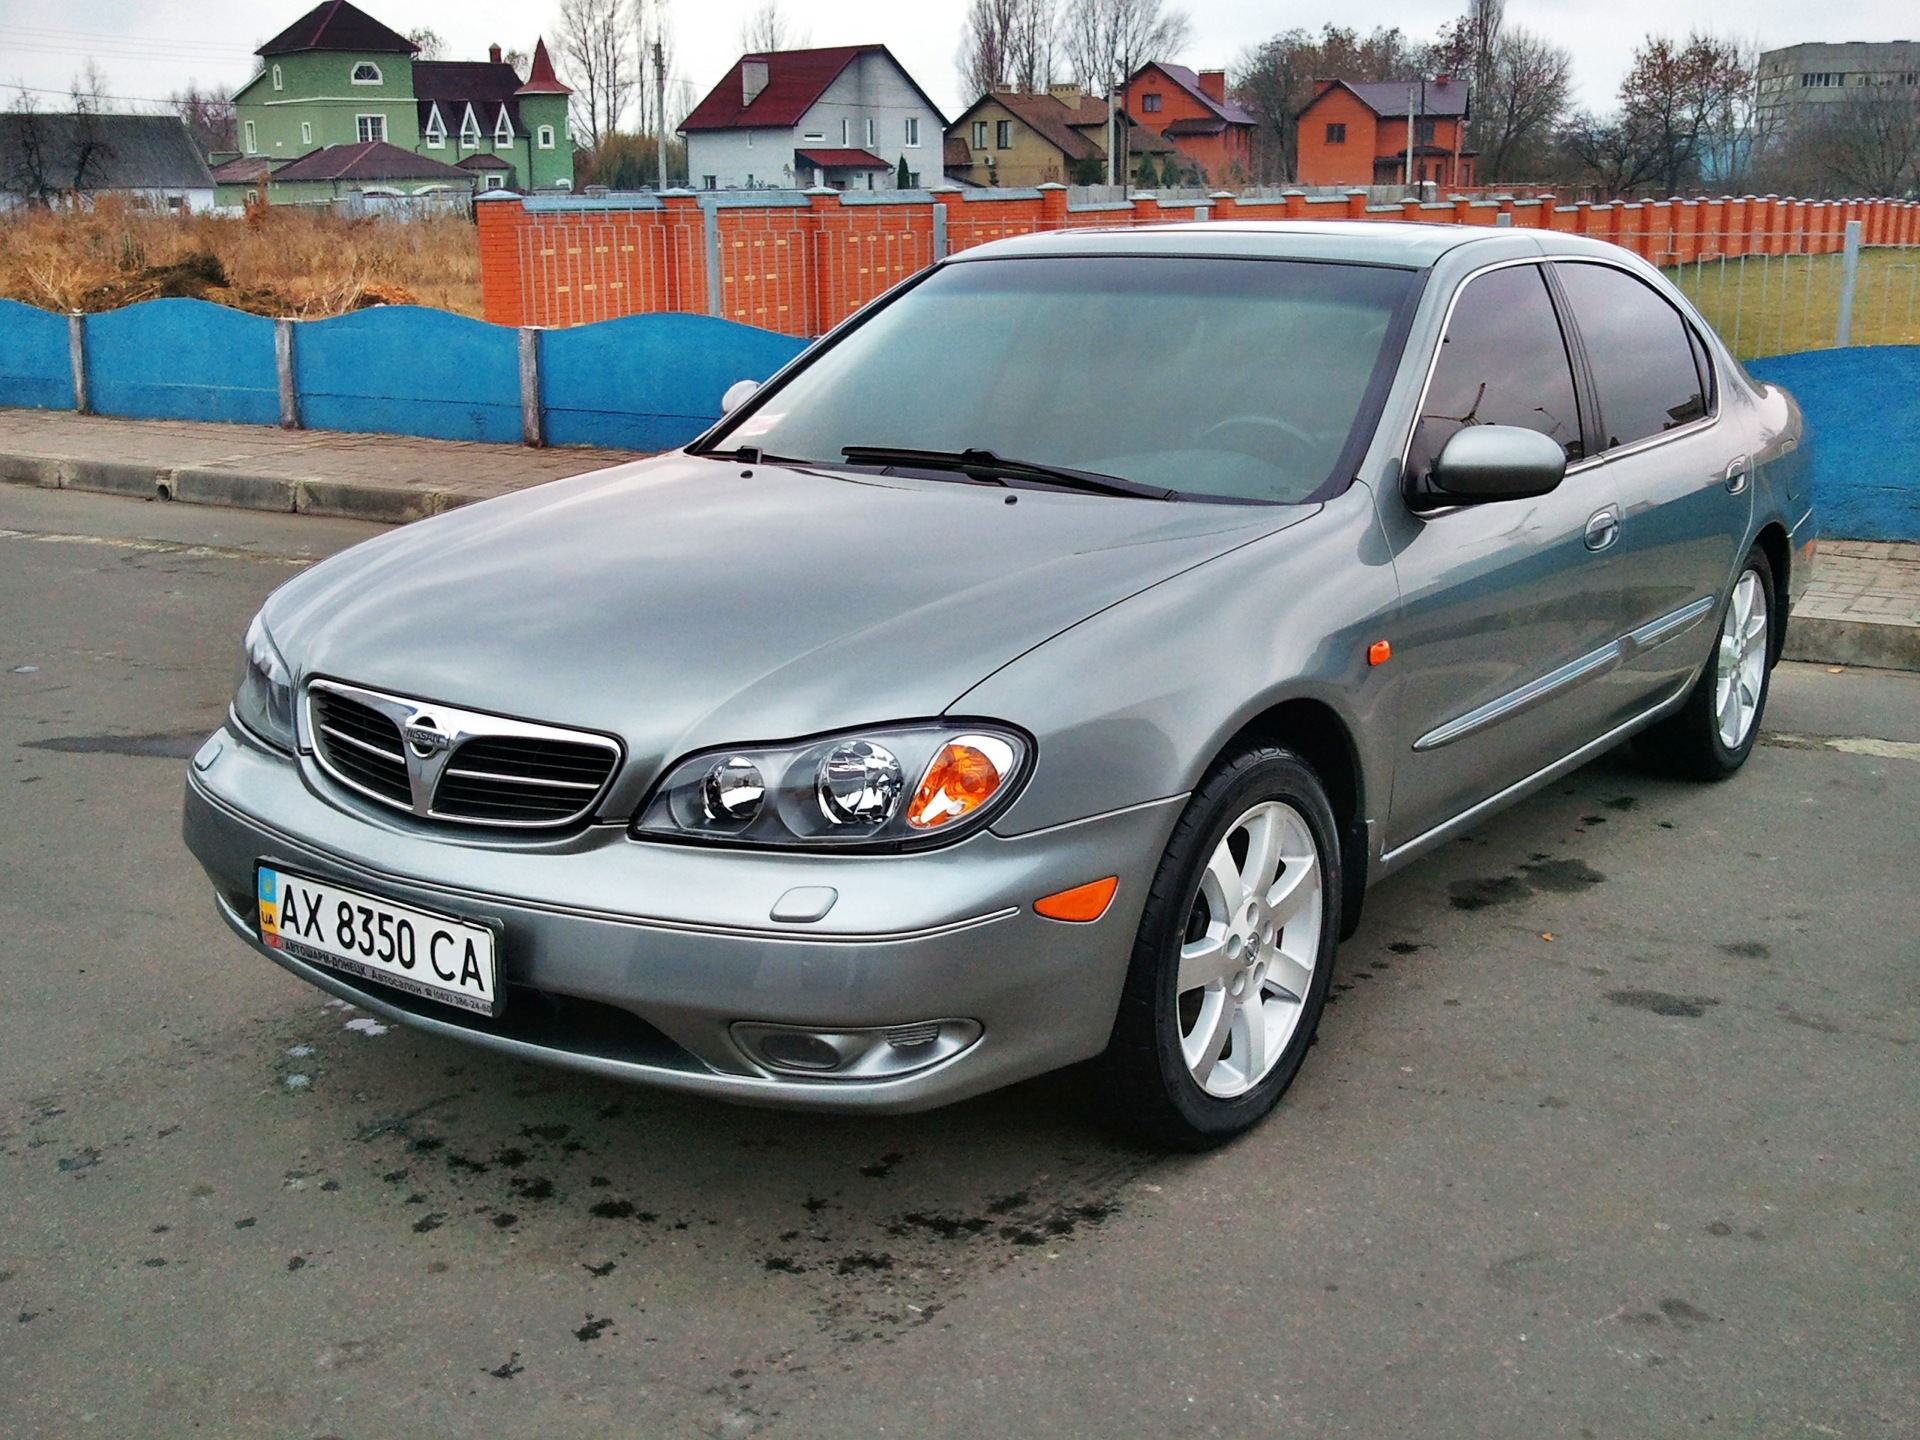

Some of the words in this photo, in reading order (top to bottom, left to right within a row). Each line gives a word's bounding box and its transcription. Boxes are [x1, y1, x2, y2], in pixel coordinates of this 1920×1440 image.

[406, 729, 446, 744] NISSAN
[261, 911, 276, 926] UA
[280, 883, 325, 942] AX
[336, 900, 416, 970] 8350
[430, 930, 485, 992] CA
